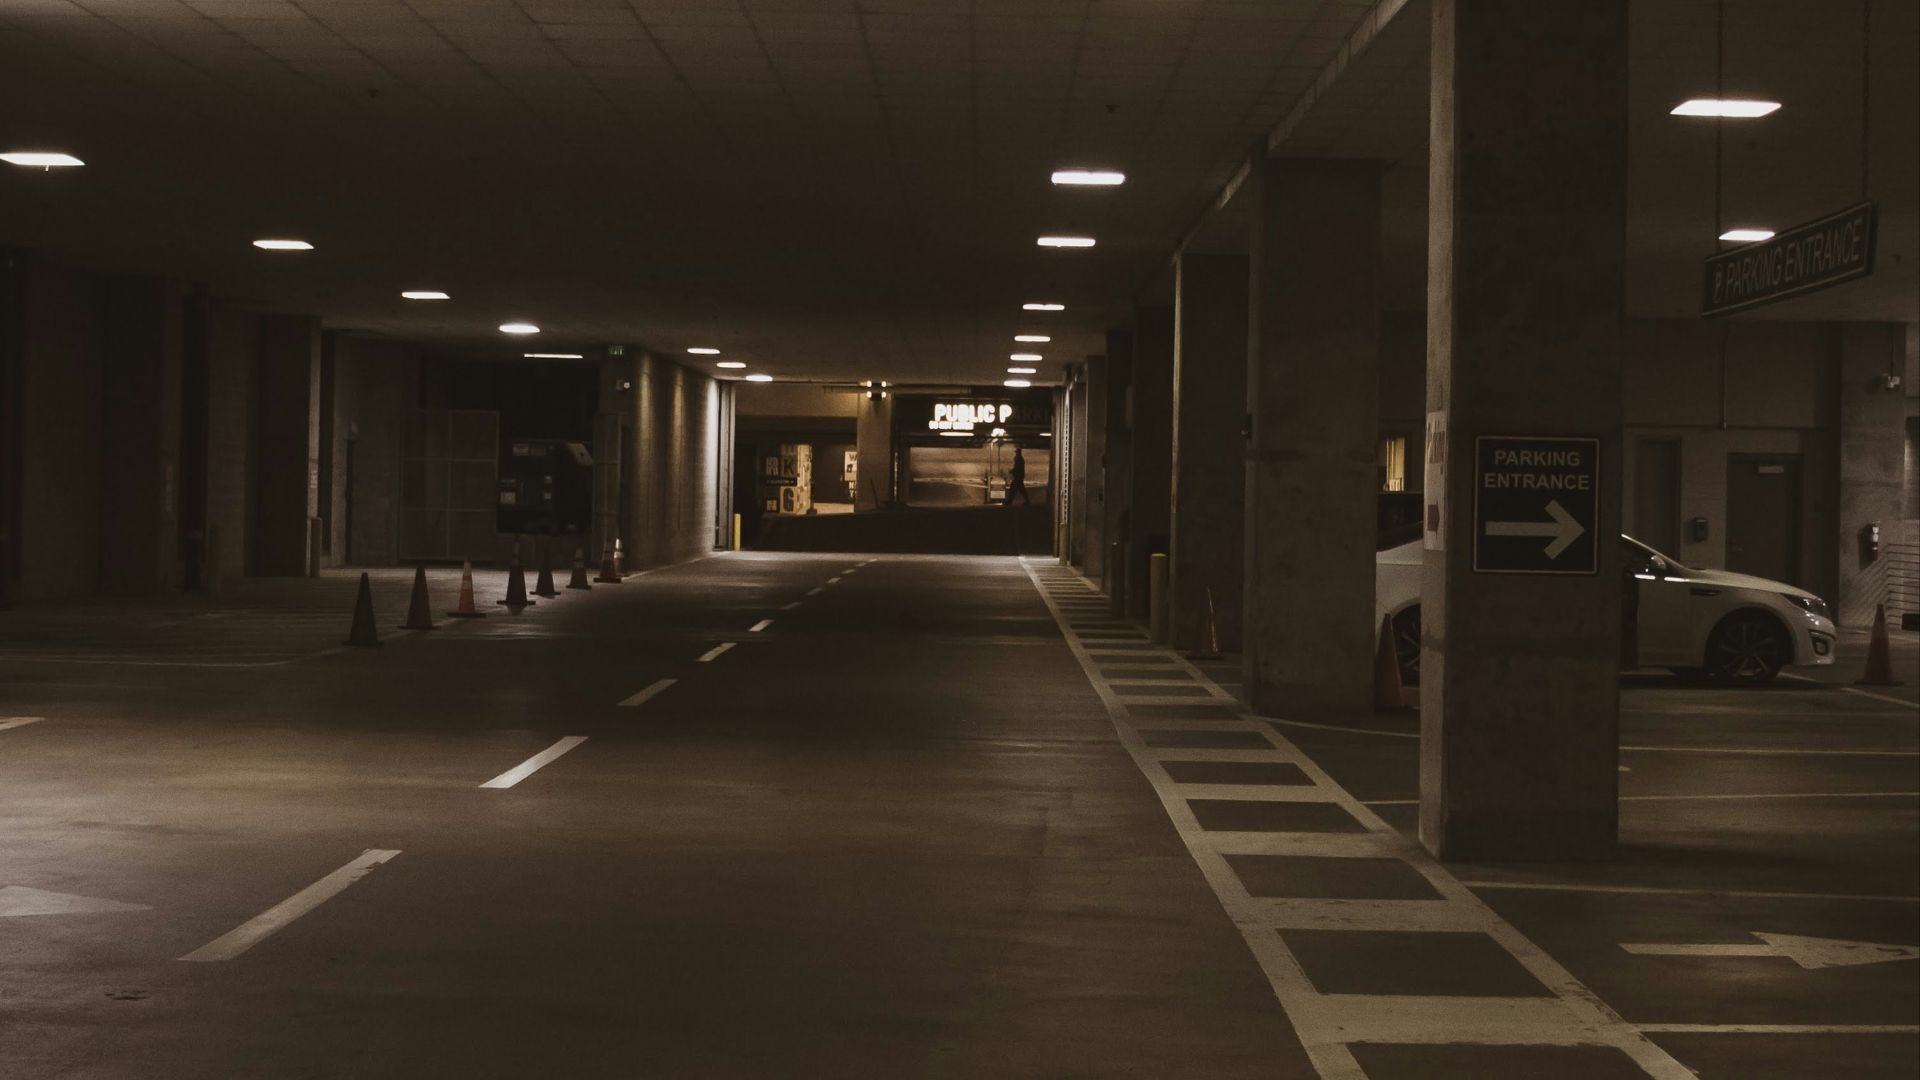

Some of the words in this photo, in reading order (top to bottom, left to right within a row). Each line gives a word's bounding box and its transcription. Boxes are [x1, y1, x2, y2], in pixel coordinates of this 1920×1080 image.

[1725, 247, 1782, 298] PARKING
[1784, 218, 1863, 282] ENTRANCE
[935, 404, 995, 423] PUBLIC
[1494, 450, 1581, 467] PARKING
[1484, 473, 1590, 490] ENTRANCE
